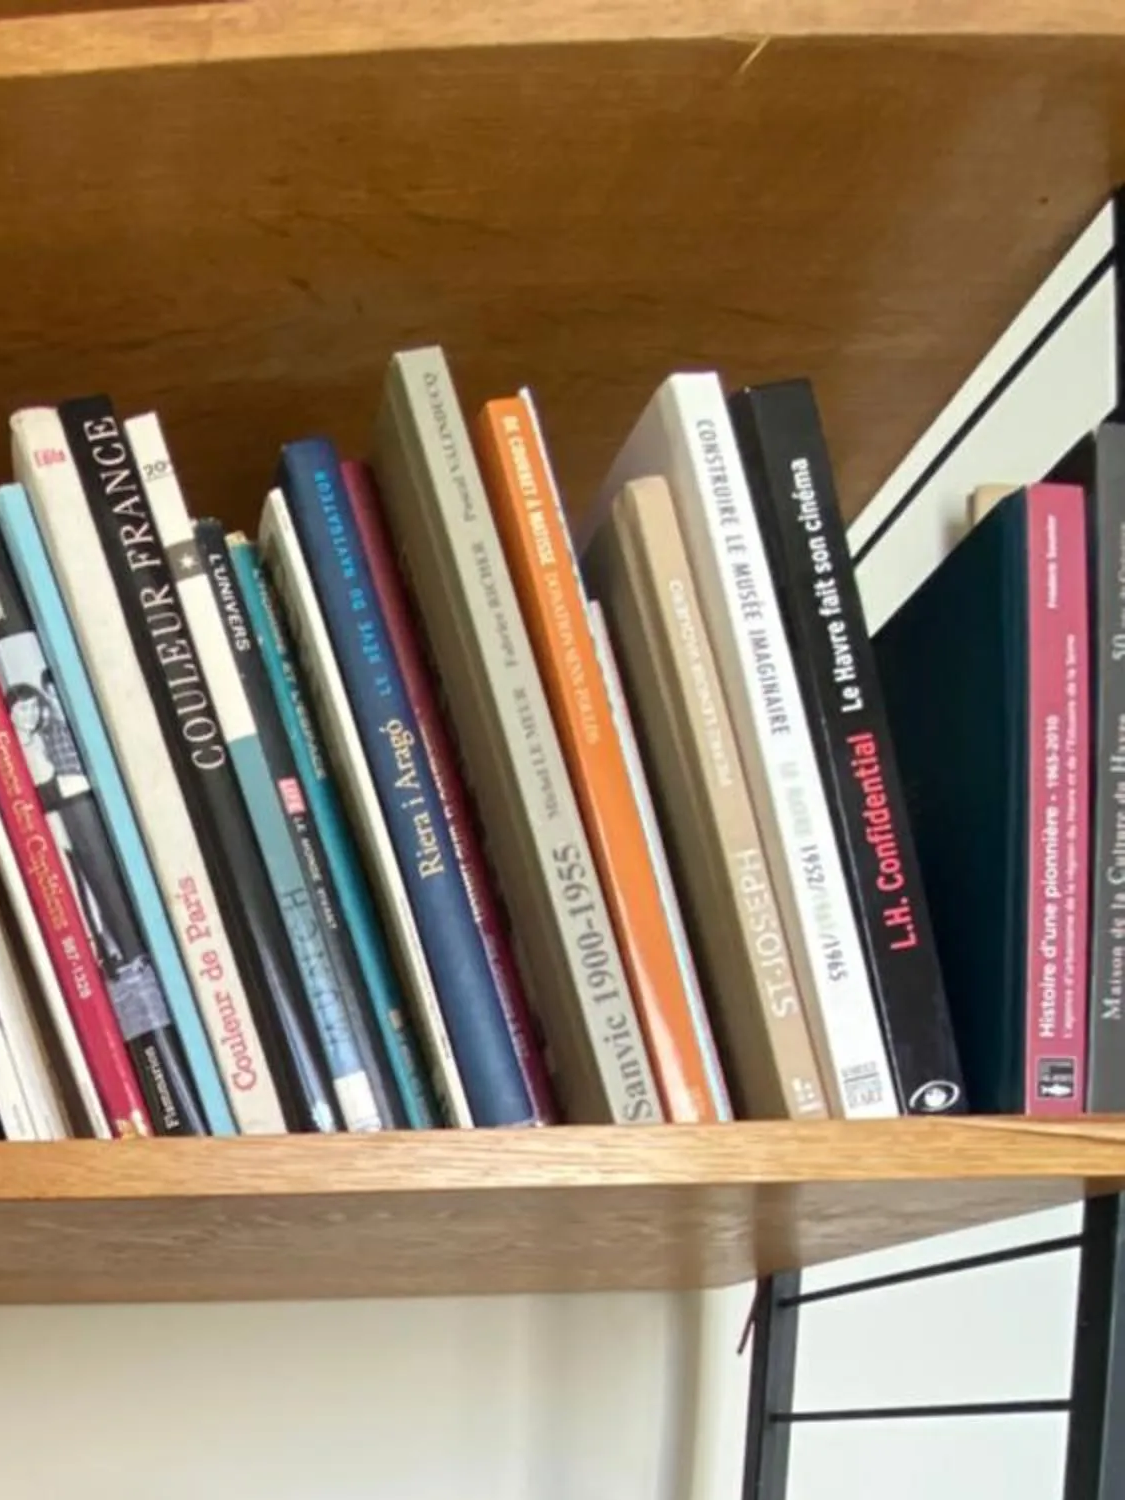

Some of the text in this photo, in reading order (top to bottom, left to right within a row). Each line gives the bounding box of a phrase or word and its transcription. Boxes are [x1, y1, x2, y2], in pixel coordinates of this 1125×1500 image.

[83, 411, 227, 774] COULEUR FRANCE
[209, 550, 249, 653] L'UNIVERS
[313, 468, 391, 697] LE RÊVE DU NAVIGATEUR
[695, 415, 790, 739] CONSTRUIRE LE MUSÉE IMAGINAIRE
[786, 455, 862, 713] Le Havre fait son cinéma
[379, 715, 424, 794] Aragó
[12, 796, 39, 834] des
[401, 795, 423, 809] i
[406, 810, 444, 879] Riera
[844, 730, 917, 952] L.H. Confidential
[20, 831, 73, 933] Capétiens
[1044, 806, 1063, 897] pionnière
[1040, 903, 1057, 958] d'une
[1108, 916, 1124, 940] de
[171, 874, 259, 1094] Couleur de Paris
[549, 840, 654, 1125] Sanvic 1900-1955
[1039, 962, 1057, 1037] Histoire
[1100, 945, 1123, 1019] Maison
[140, 1045, 179, 1129] Flammarion
